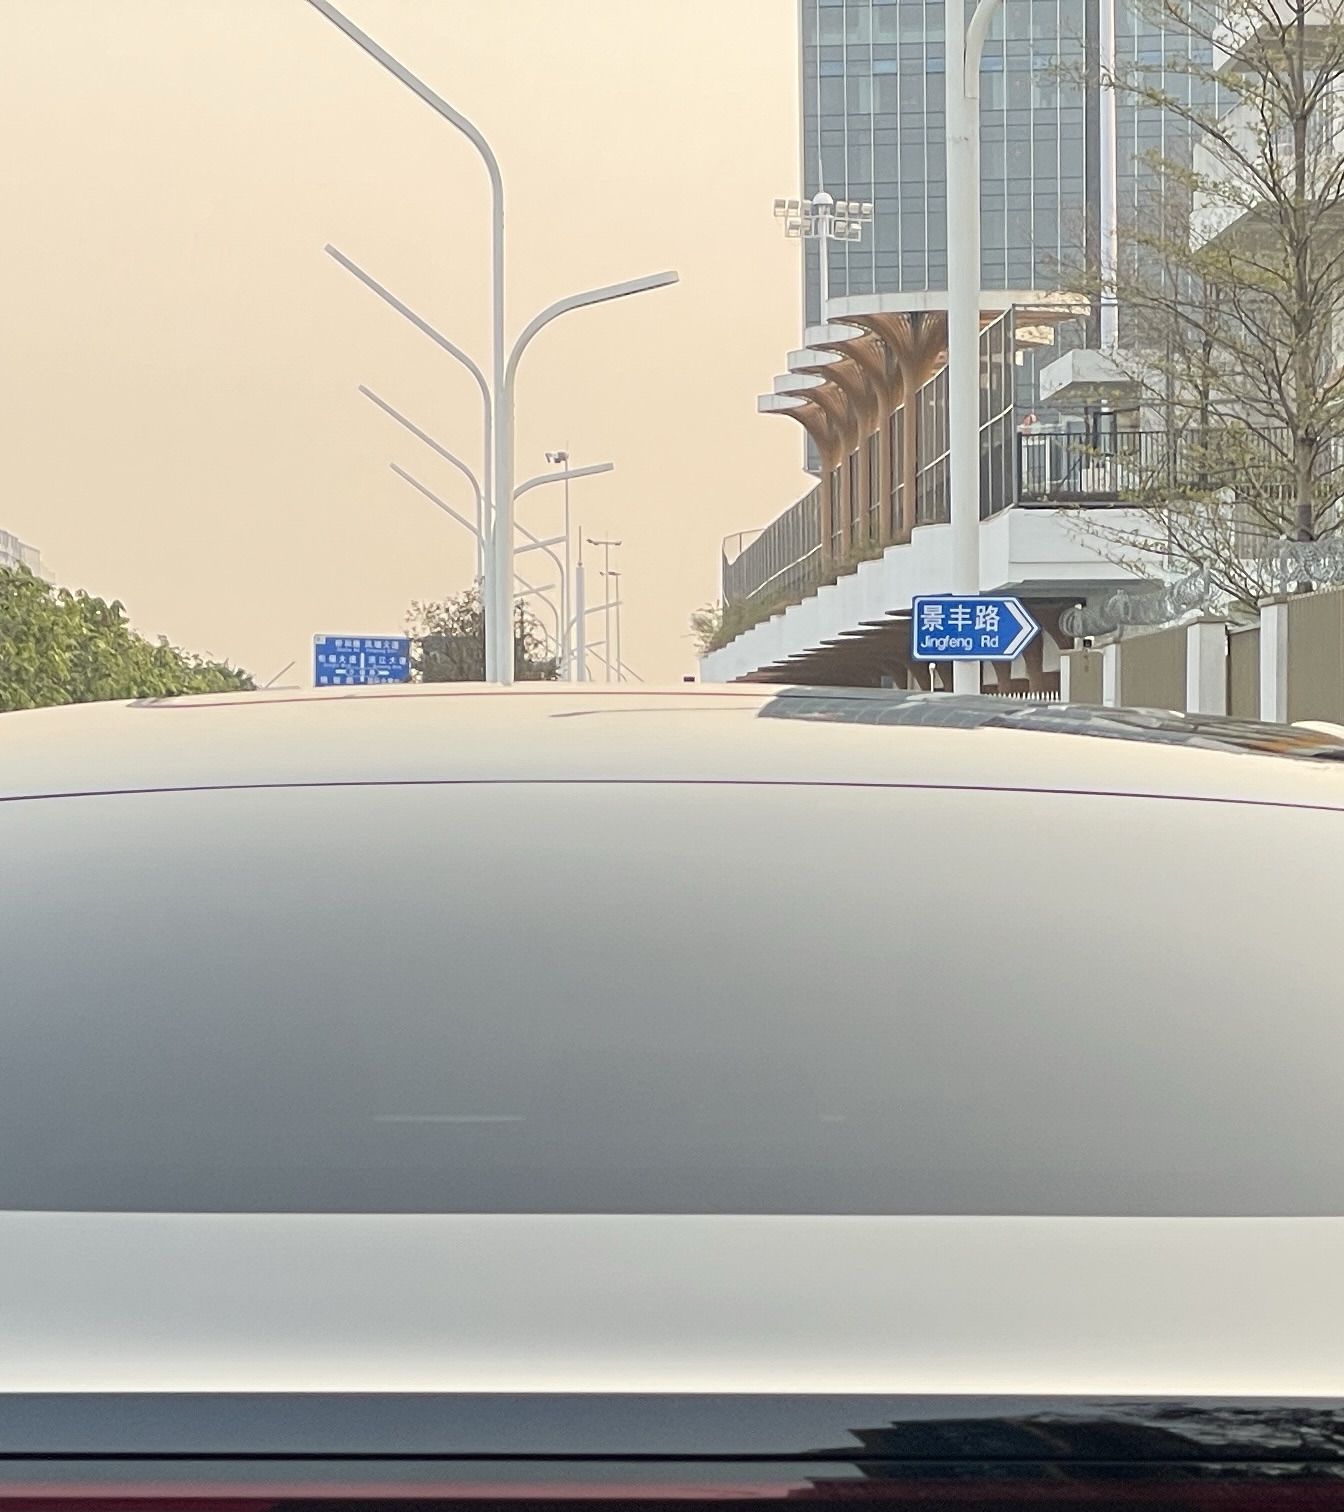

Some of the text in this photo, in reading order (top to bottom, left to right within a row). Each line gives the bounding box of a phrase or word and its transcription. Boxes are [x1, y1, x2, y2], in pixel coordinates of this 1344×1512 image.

[920, 604, 1000, 632] 景丰路
[920, 635, 999, 651] Jingfeng Rd
